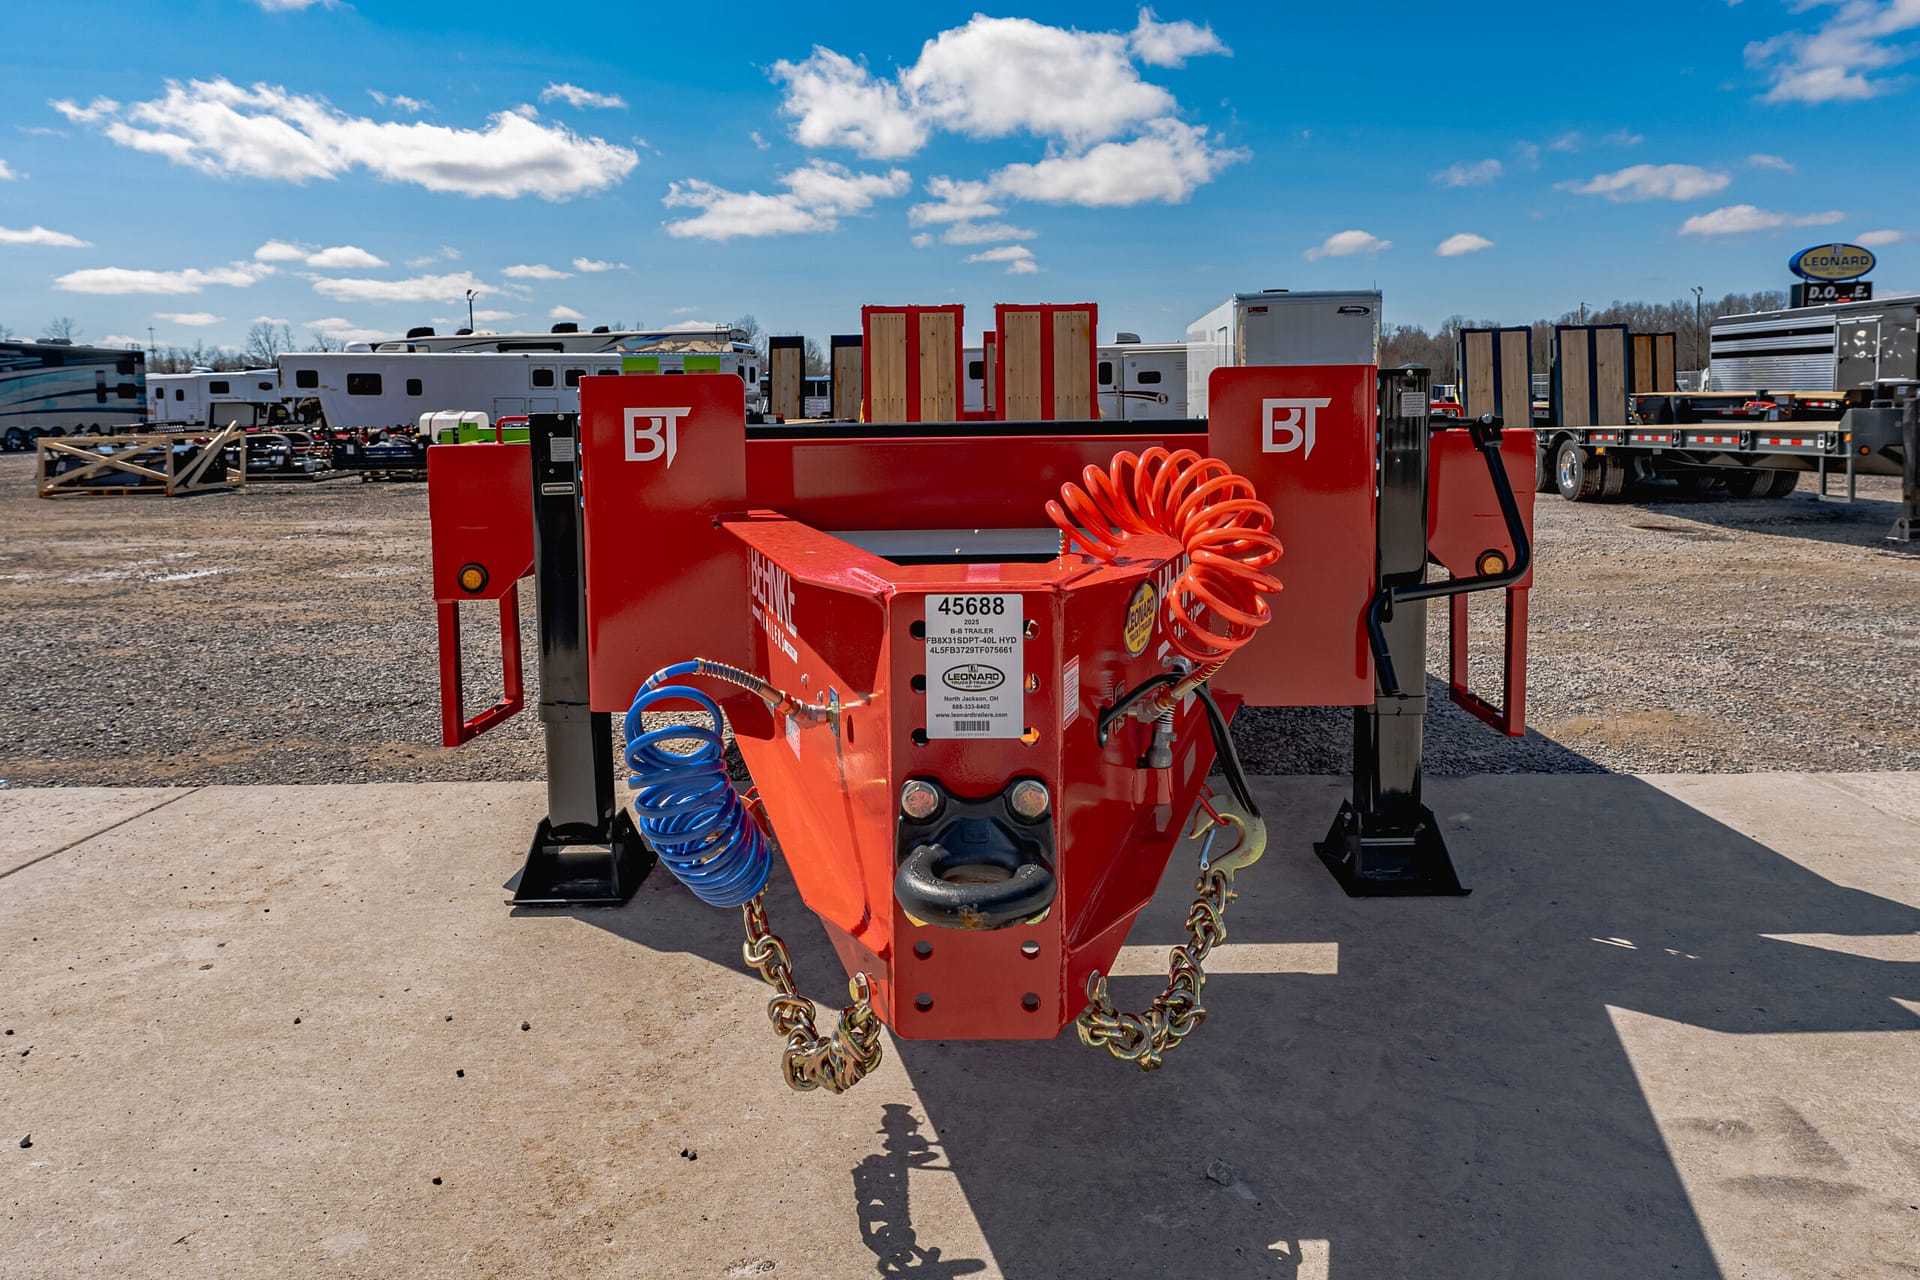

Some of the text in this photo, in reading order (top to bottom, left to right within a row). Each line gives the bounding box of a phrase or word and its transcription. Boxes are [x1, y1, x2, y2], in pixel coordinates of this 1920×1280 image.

[1804, 256, 1869, 267] LEONARD
[624, 407, 692, 470] BT
[1262, 398, 1332, 461] BT
[938, 597, 1005, 615] 45688
[1127, 597, 1155, 634] LEONARD
[947, 673, 1000, 681] LEONARD
